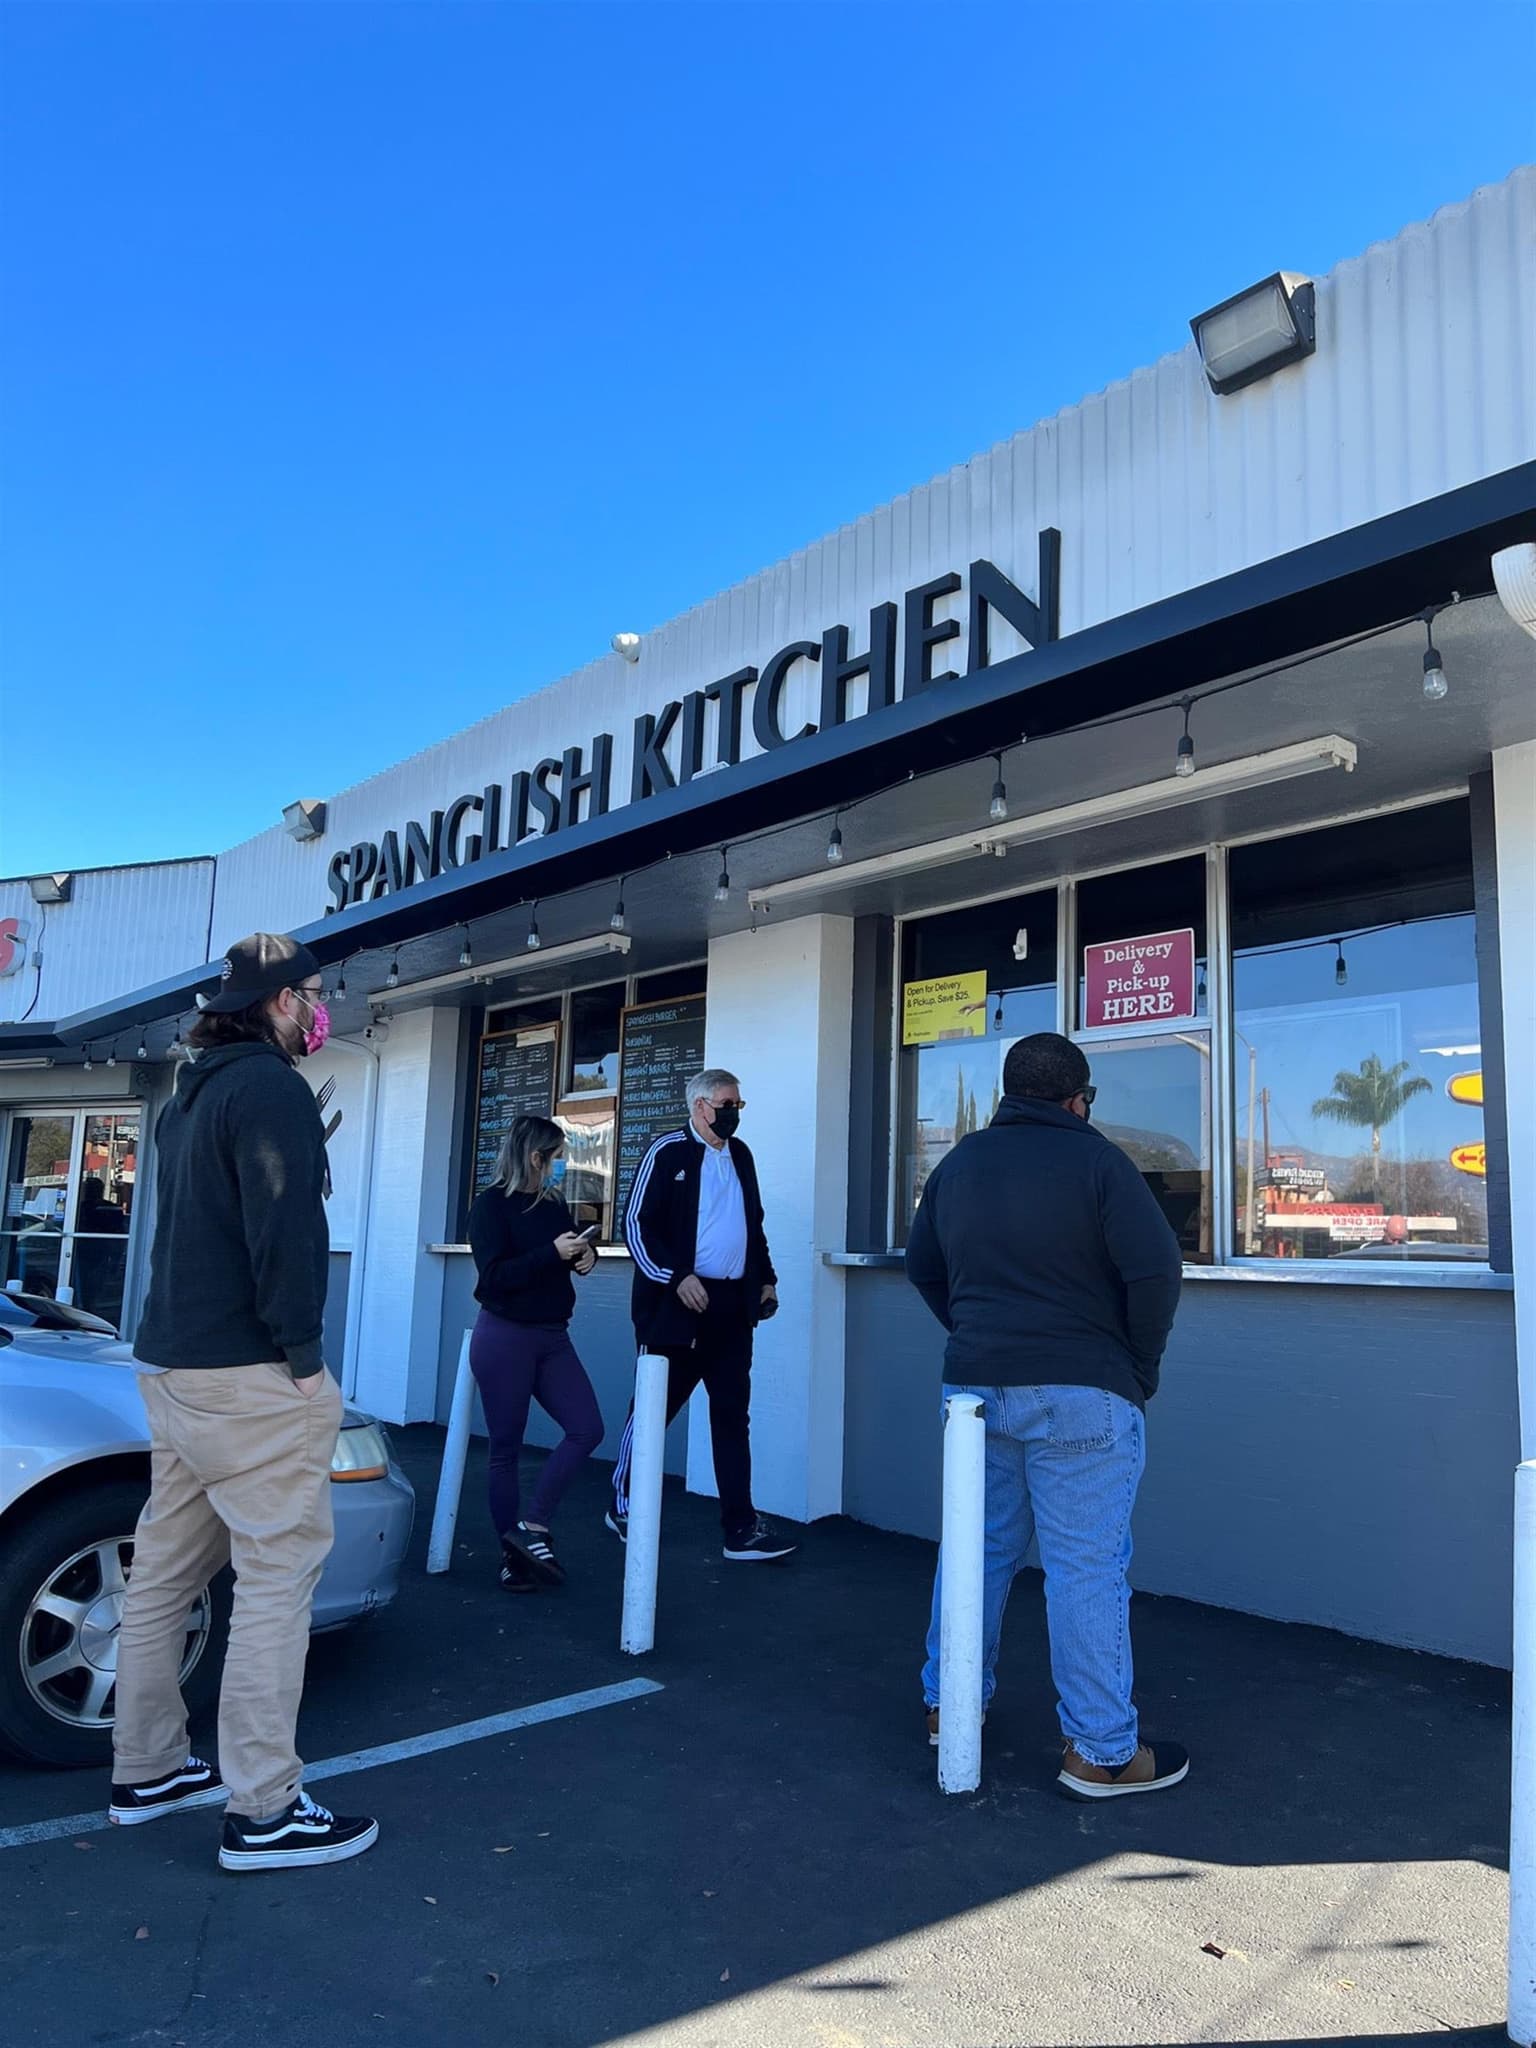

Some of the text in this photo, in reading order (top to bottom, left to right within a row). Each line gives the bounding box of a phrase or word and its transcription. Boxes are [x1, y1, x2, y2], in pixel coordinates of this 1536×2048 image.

[324, 527, 1062, 916] SPANGLISH KITCHEN
[1103, 942, 1174, 964] Delivery
[1132, 960, 1145, 975] &
[906, 981, 961, 997] Open for Delivery
[1106, 974, 1171, 994] Pick-up
[937, 994, 954, 1003] Save
[1102, 992, 1174, 1021] HERE
